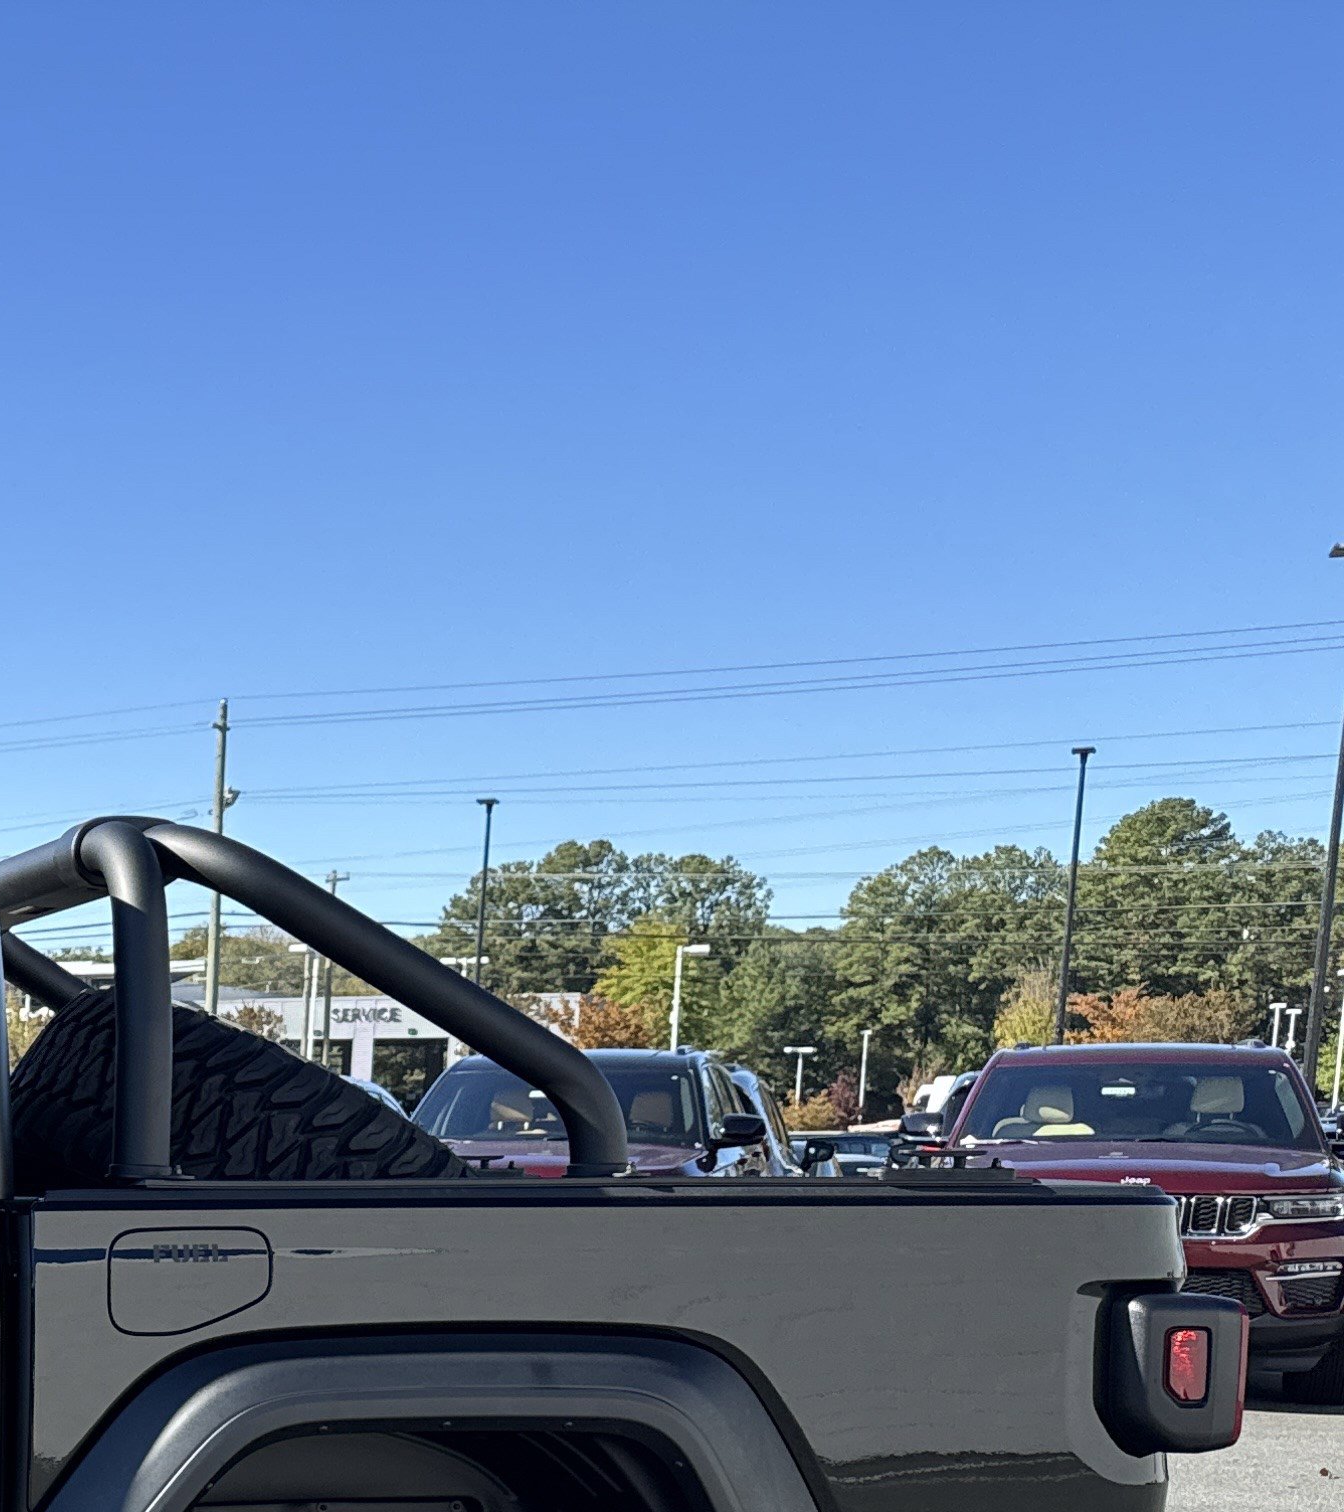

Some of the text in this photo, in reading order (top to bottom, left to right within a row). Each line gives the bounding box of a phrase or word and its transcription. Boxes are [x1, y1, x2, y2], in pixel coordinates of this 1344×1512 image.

[331, 1007, 402, 1023] SERVICE
[1120, 1176, 1151, 1186] Jeep
[152, 1243, 228, 1263] FUEL
